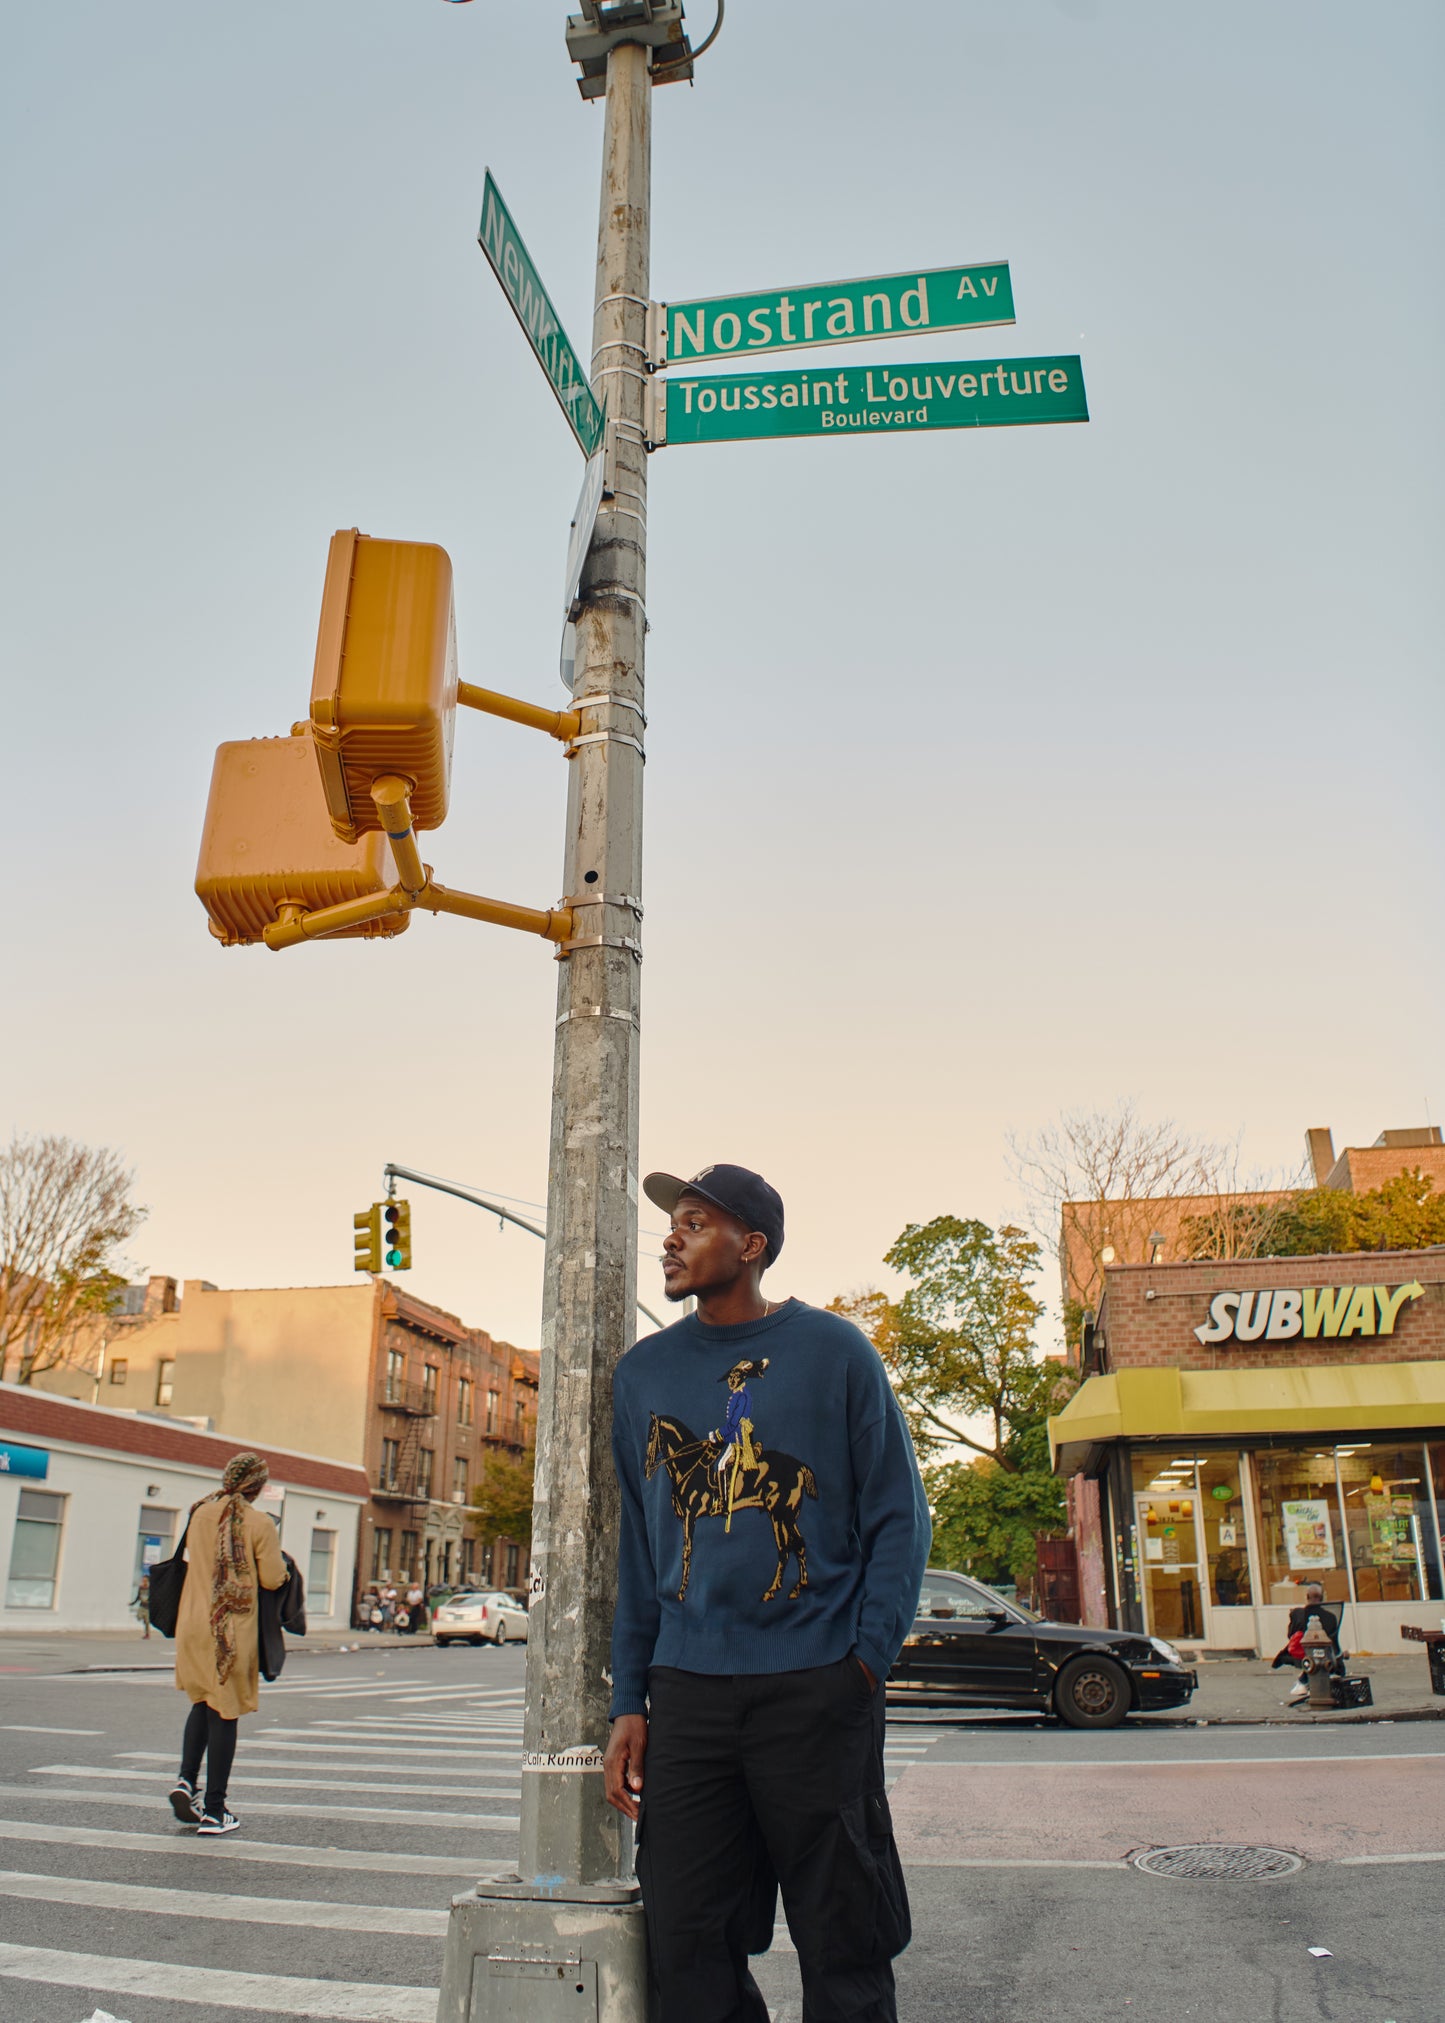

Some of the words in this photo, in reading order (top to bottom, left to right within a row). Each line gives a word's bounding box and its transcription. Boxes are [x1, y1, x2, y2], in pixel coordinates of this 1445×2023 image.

[673, 277, 930, 357] Nostrand
[956, 276, 998, 300] Av
[679, 372, 849, 413] Toussaint
[866, 364, 1068, 402] L'ouverture
[821, 405, 928, 428] Boulevard
[1193, 1279, 1426, 1346] SUBWAY
[1223, 1529, 1233, 1540] A
